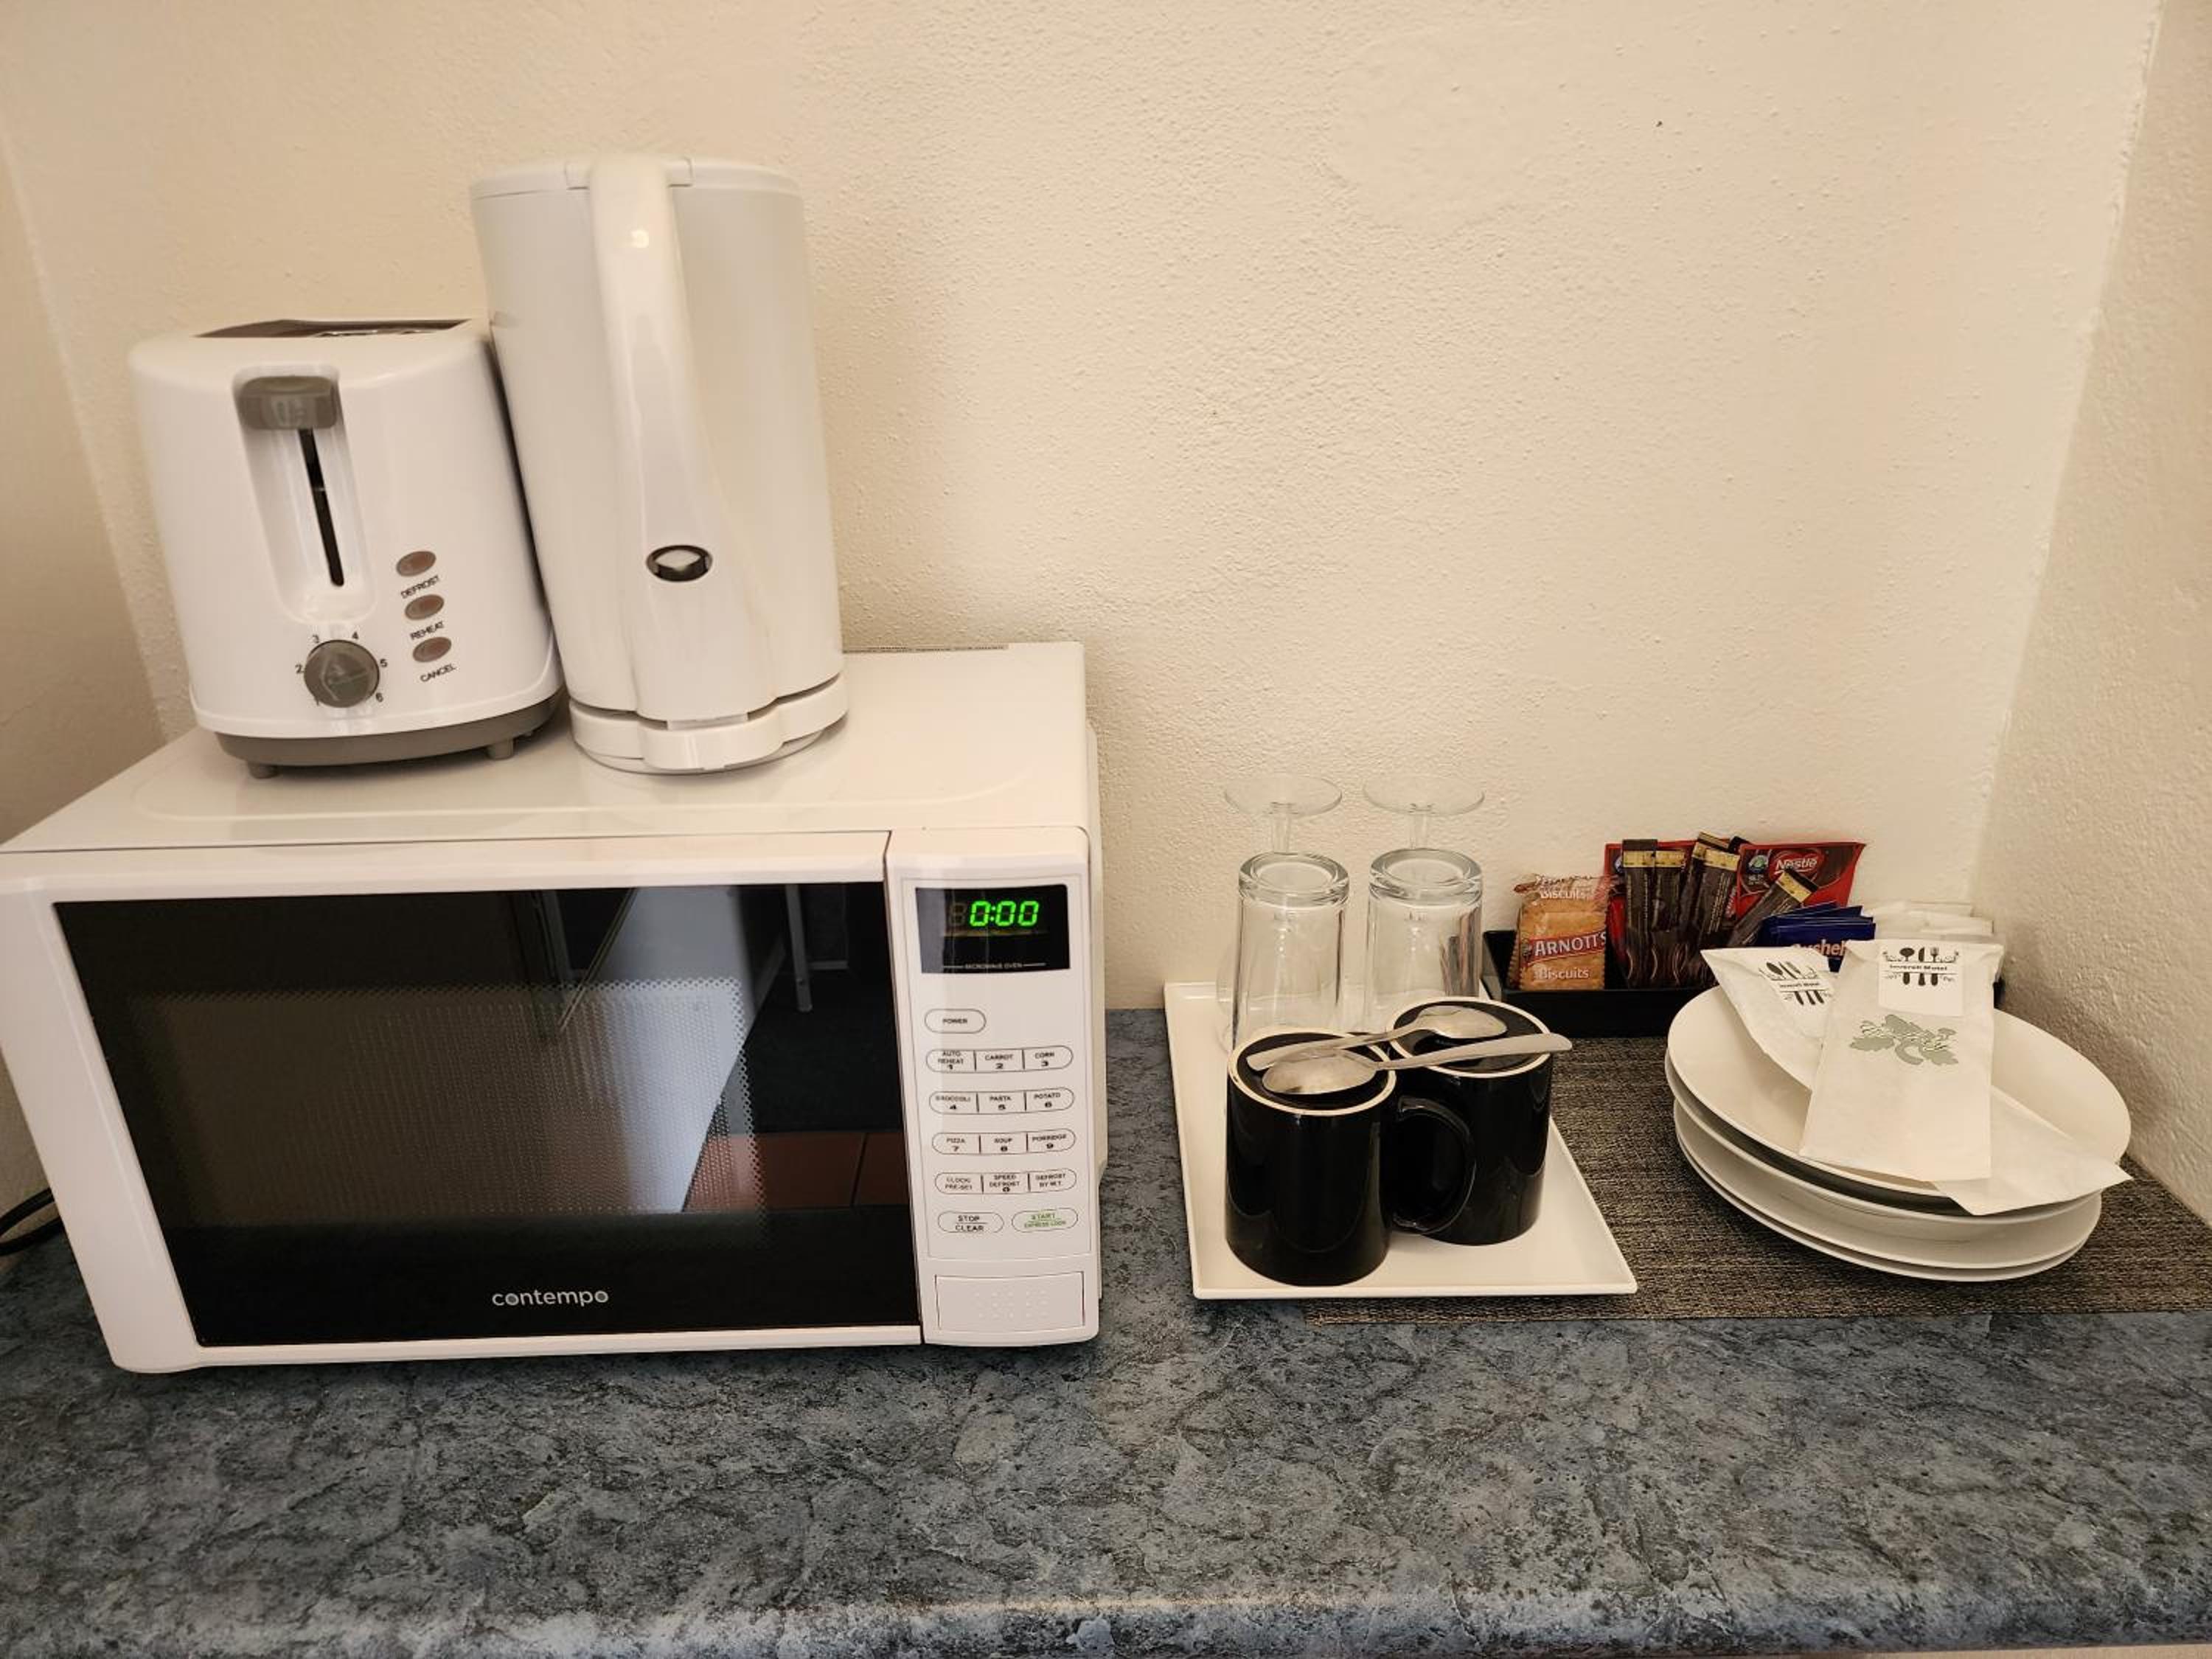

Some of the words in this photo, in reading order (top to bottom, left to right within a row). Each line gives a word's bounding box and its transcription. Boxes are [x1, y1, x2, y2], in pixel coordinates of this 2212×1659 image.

[400, 575, 440, 599] DEFROST
[352, 632, 359, 640] 4
[410, 621, 445, 641] REHEAT
[313, 635, 320, 644] 3
[296, 664, 305, 674] 2
[380, 658, 388, 668] 5
[420, 664, 457, 683] CANCEL
[375, 692, 384, 703] 6
[970, 900, 1040, 927] 0:00
[1534, 931, 1606, 957] ARNOTT'S
[1538, 967, 1590, 980] Biscuits
[492, 1289, 609, 1307] contempo
